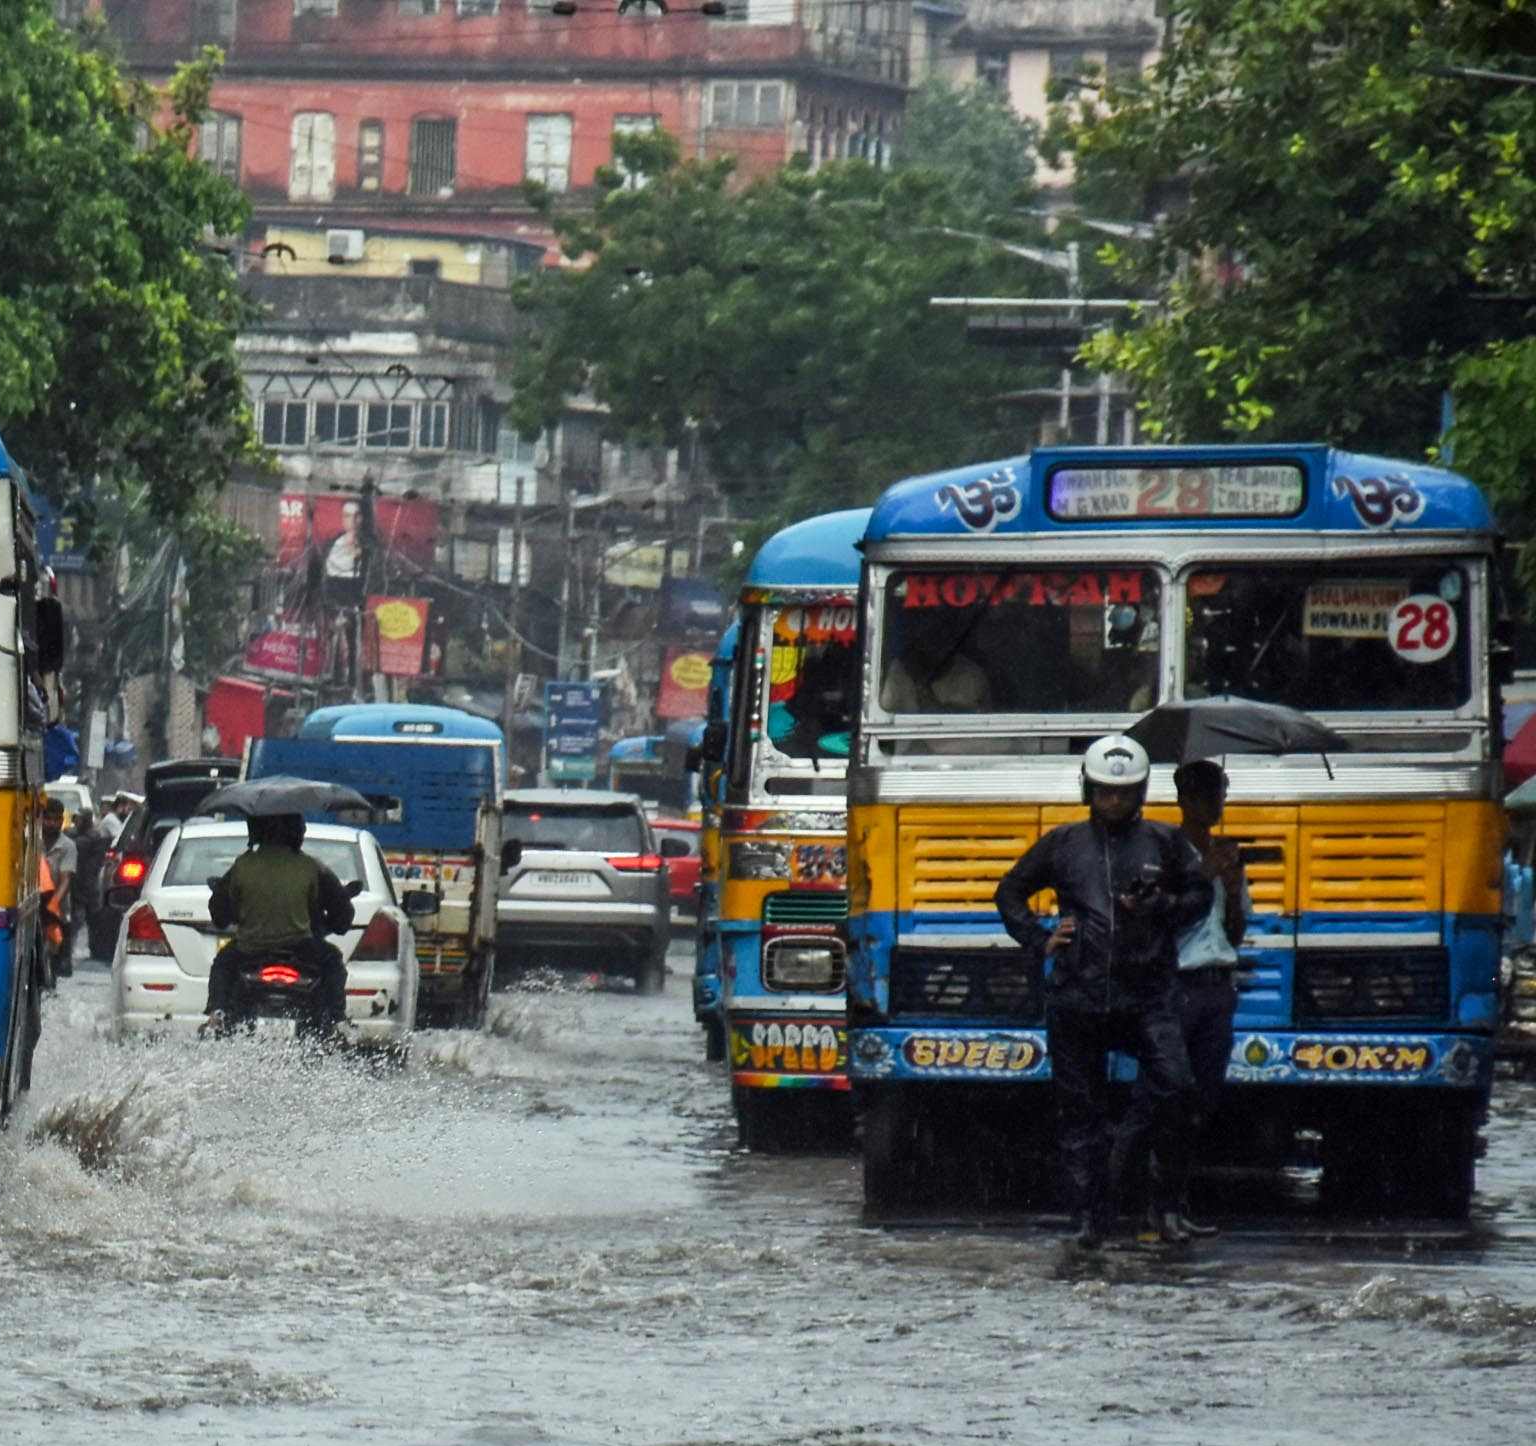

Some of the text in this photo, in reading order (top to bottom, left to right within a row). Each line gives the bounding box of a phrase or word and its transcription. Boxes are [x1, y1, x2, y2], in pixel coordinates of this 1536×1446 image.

[1135, 469, 1214, 515] 28
[1396, 602, 1451, 650] 28
[912, 1038, 1035, 1070] SPEED
